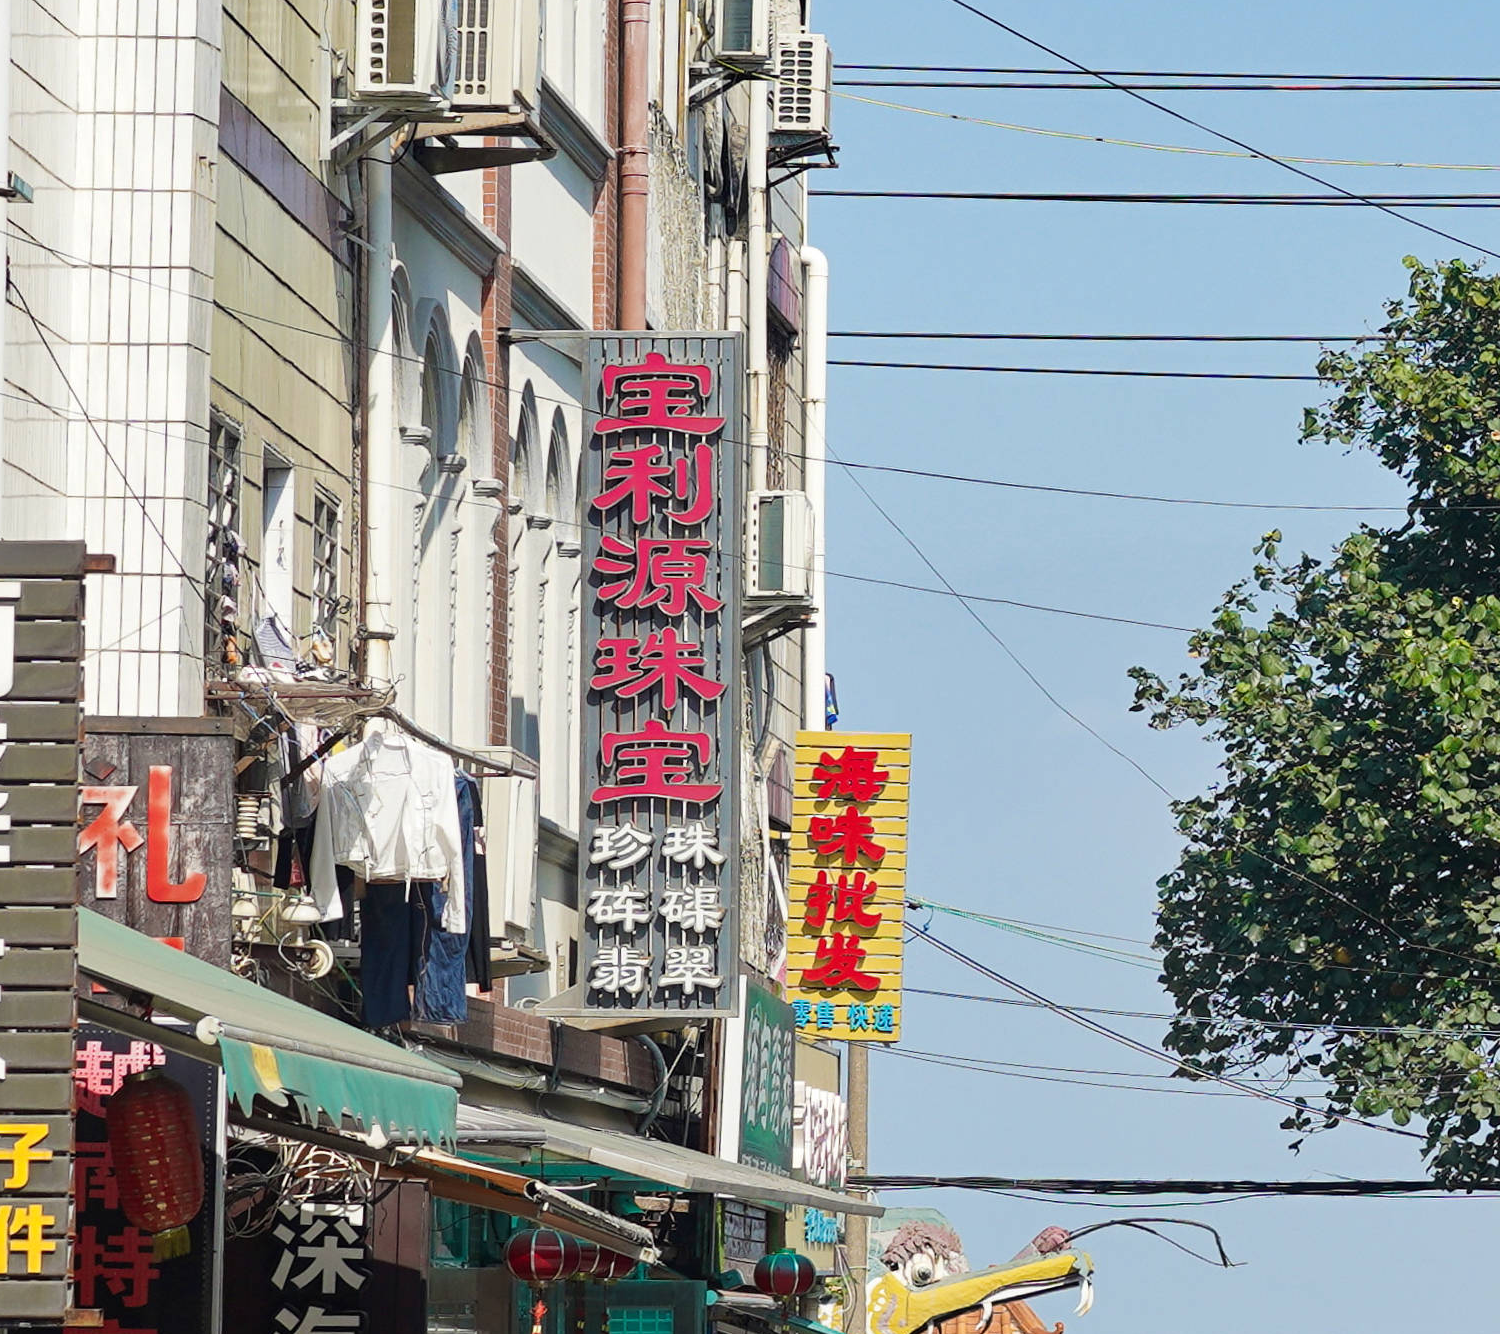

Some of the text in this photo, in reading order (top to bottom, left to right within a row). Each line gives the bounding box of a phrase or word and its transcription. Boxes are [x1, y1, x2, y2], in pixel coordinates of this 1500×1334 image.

[589, 351, 728, 806] 宝利源珠宝
[589, 822, 726, 873] 珍珠
[804, 745, 891, 994] 海味批发
[587, 883, 725, 934] 砗磲
[588, 945, 723, 995] 翡翠
